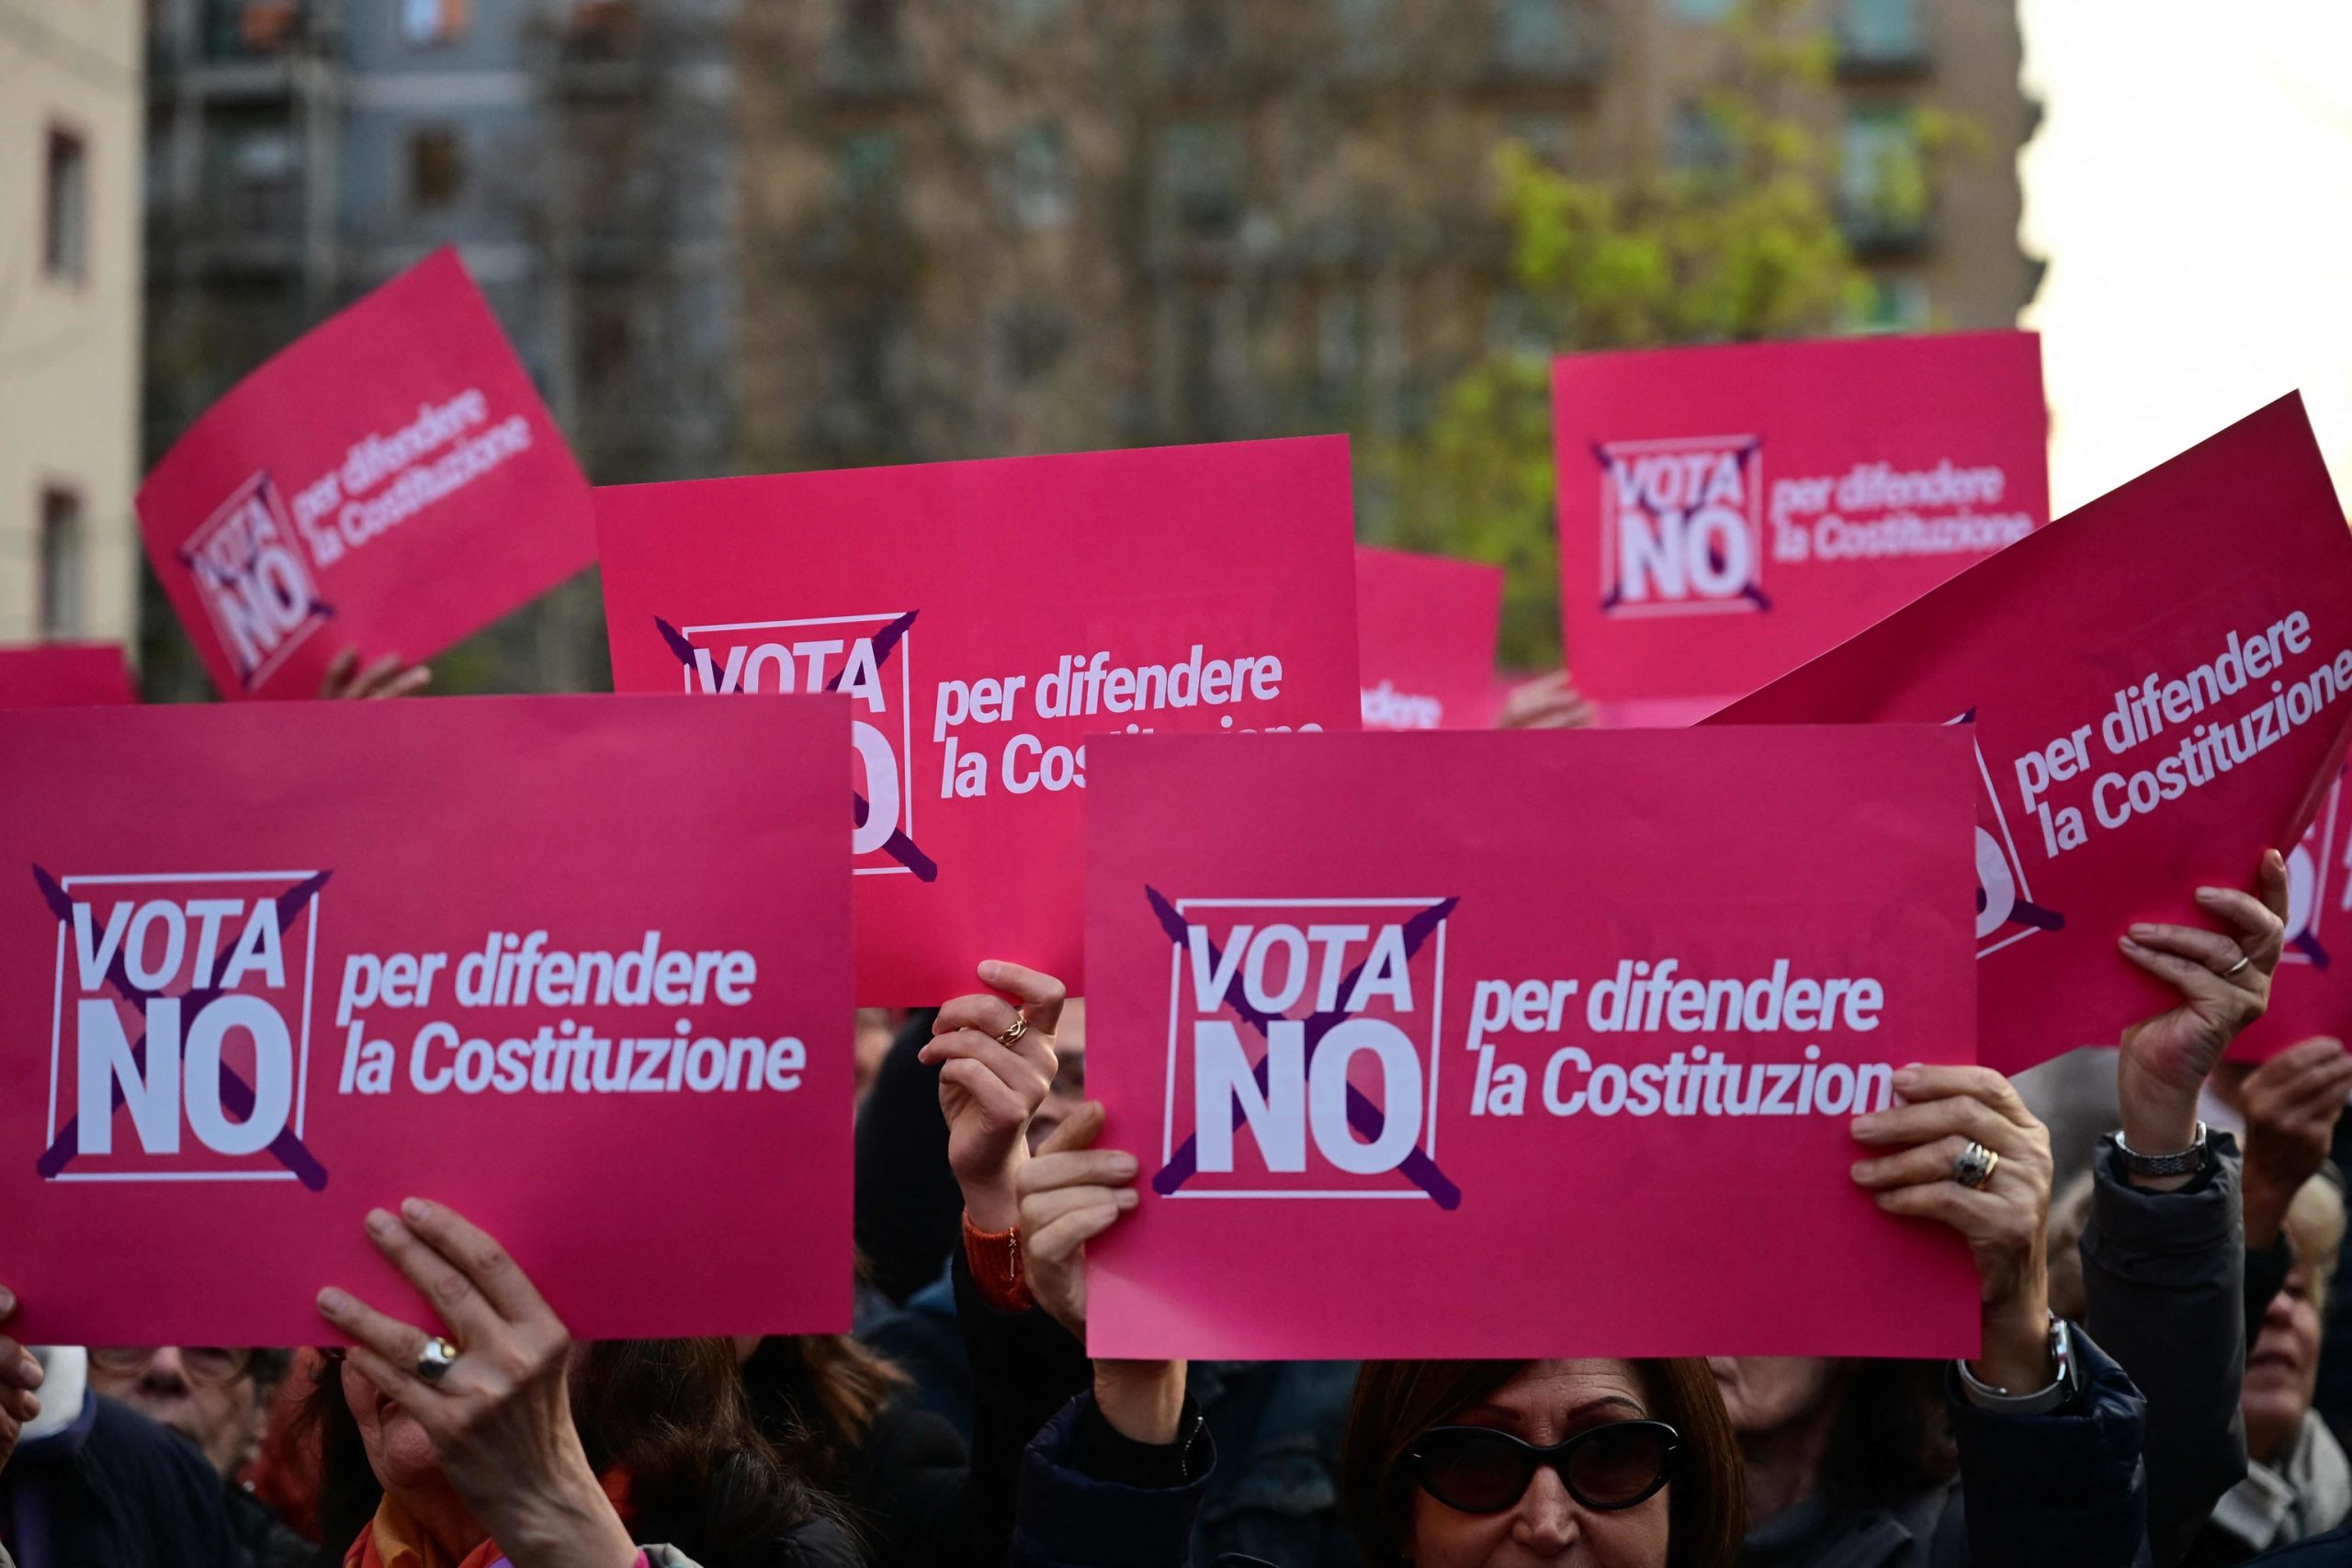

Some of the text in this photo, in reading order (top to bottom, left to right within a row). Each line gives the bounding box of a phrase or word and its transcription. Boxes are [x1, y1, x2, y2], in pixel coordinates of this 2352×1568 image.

[292, 389, 486, 538] per difendere
[309, 414, 531, 570] la Costituzione
[1614, 454, 1742, 507] VOTA
[1770, 458, 2005, 526] per difendere
[1619, 507, 1751, 601] NO
[1774, 520, 1809, 561] la
[220, 546, 309, 669] NO
[694, 638, 886, 712] VOTA
[933, 677, 1025, 742] per
[1035, 645, 1282, 718] difendere
[2014, 610, 2312, 815] per difendere
[940, 736, 987, 798] la
[2037, 649, 2352, 858] la Costituzione
[74, 899, 285, 989] VOTA
[337, 931, 755, 1025] per difendere
[1188, 925, 1413, 1012] VOTA
[1467, 959, 1883, 1049] per difendere
[78, 995, 291, 1154] NO
[339, 1020, 805, 1093] la Costituzione
[1194, 1019, 1422, 1174] NO
[1471, 1045, 1923, 1116] la Costituzion
